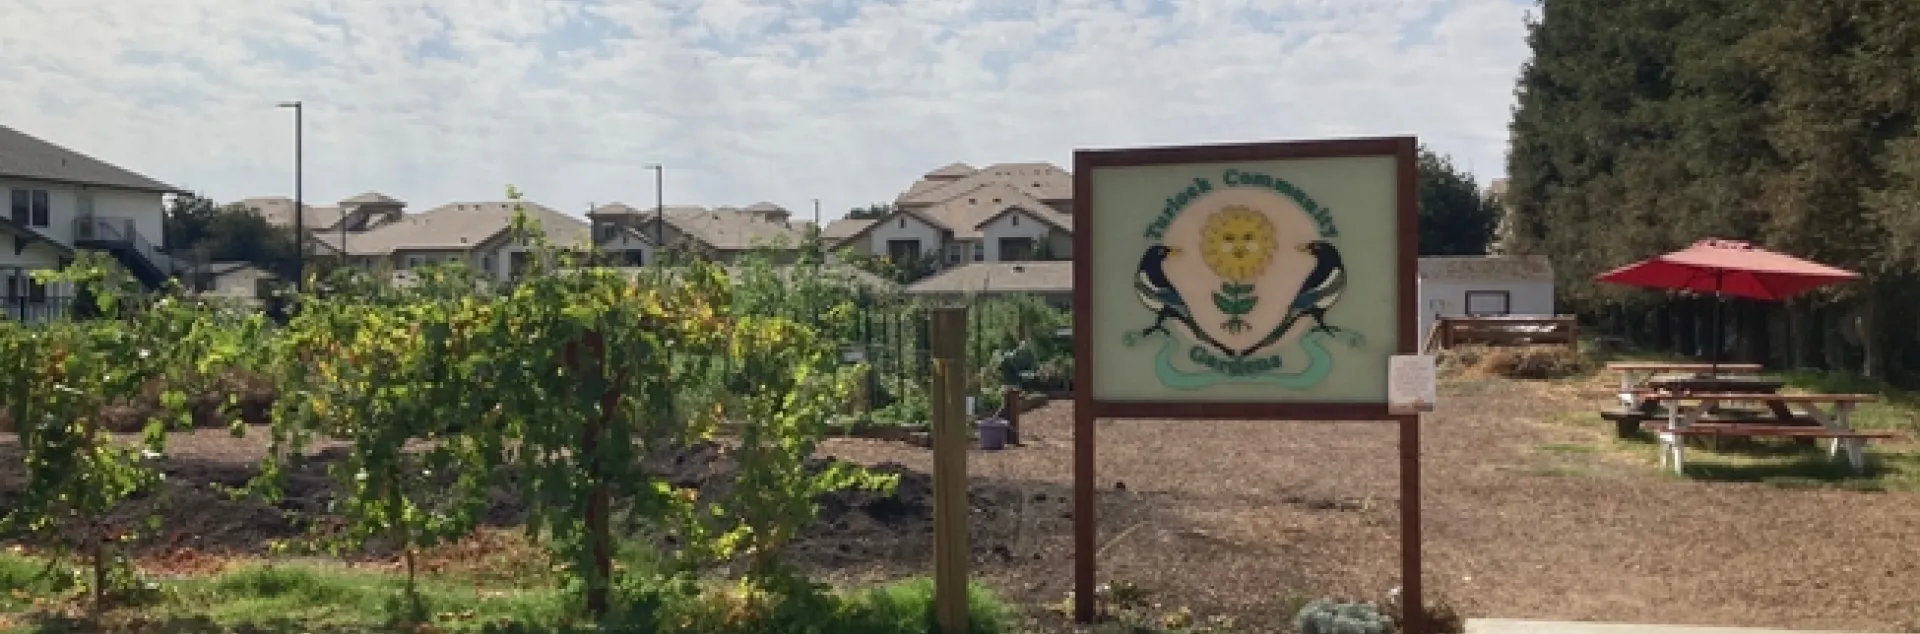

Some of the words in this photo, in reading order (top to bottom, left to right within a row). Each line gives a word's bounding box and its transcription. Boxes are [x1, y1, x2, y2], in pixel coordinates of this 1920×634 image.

[1143, 177, 1212, 239] Turlock
[1223, 168, 1339, 238] Community
[1189, 346, 1283, 376] Gardens
